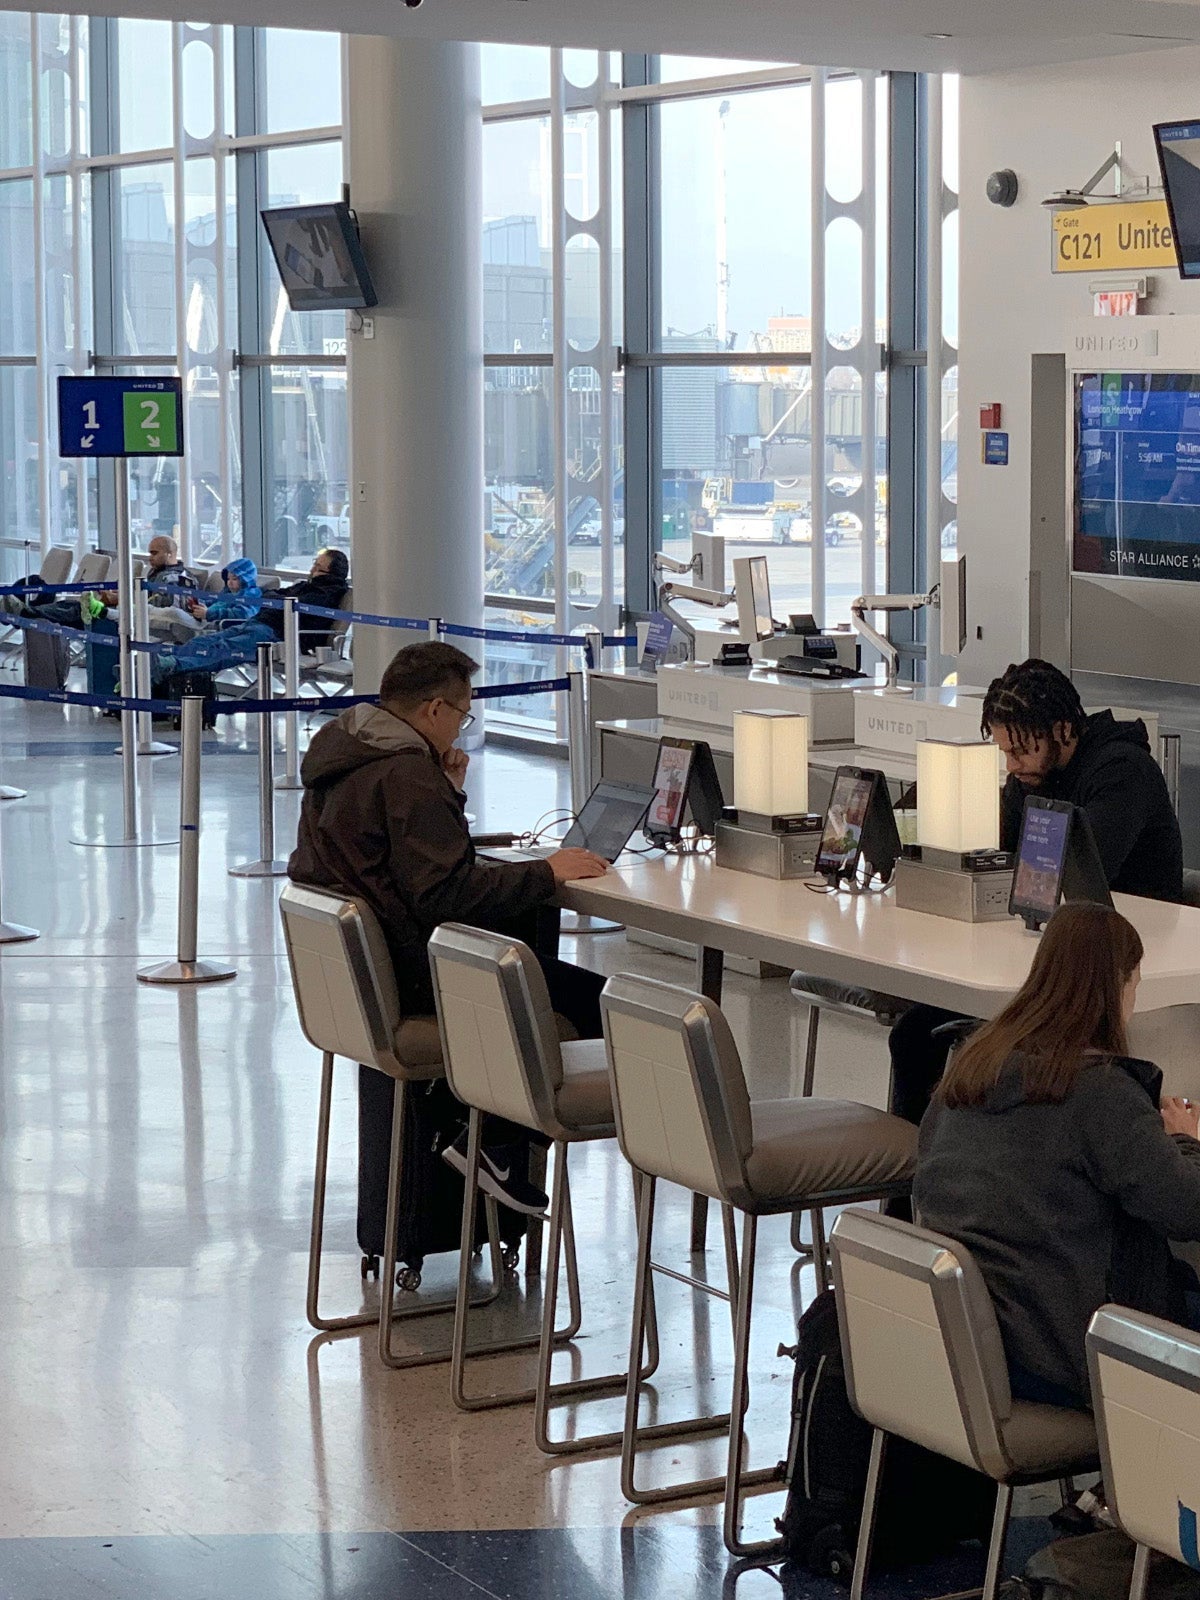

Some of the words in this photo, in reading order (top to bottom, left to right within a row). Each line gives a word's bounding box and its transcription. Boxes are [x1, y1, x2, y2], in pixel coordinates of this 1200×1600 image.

[1063, 218, 1079, 228] Gate
[1060, 233, 1101, 260] C121
[1075, 335, 1139, 351] UNITED
[82, 400, 100, 429] 1
[140, 400, 160, 429] 2
[1088, 404, 1111, 414] London
[1111, 404, 1143, 415] Heathrow
[1175, 442, 1186, 453] On
[1102, 451, 1112, 461] PM
[1151, 453, 1163, 463] AM
[1109, 550, 1135, 564] STAR
[1138, 551, 1189, 567] ALLIANCE
[668, 689, 708, 705] UNITED
[867, 717, 914, 735] UNITED
